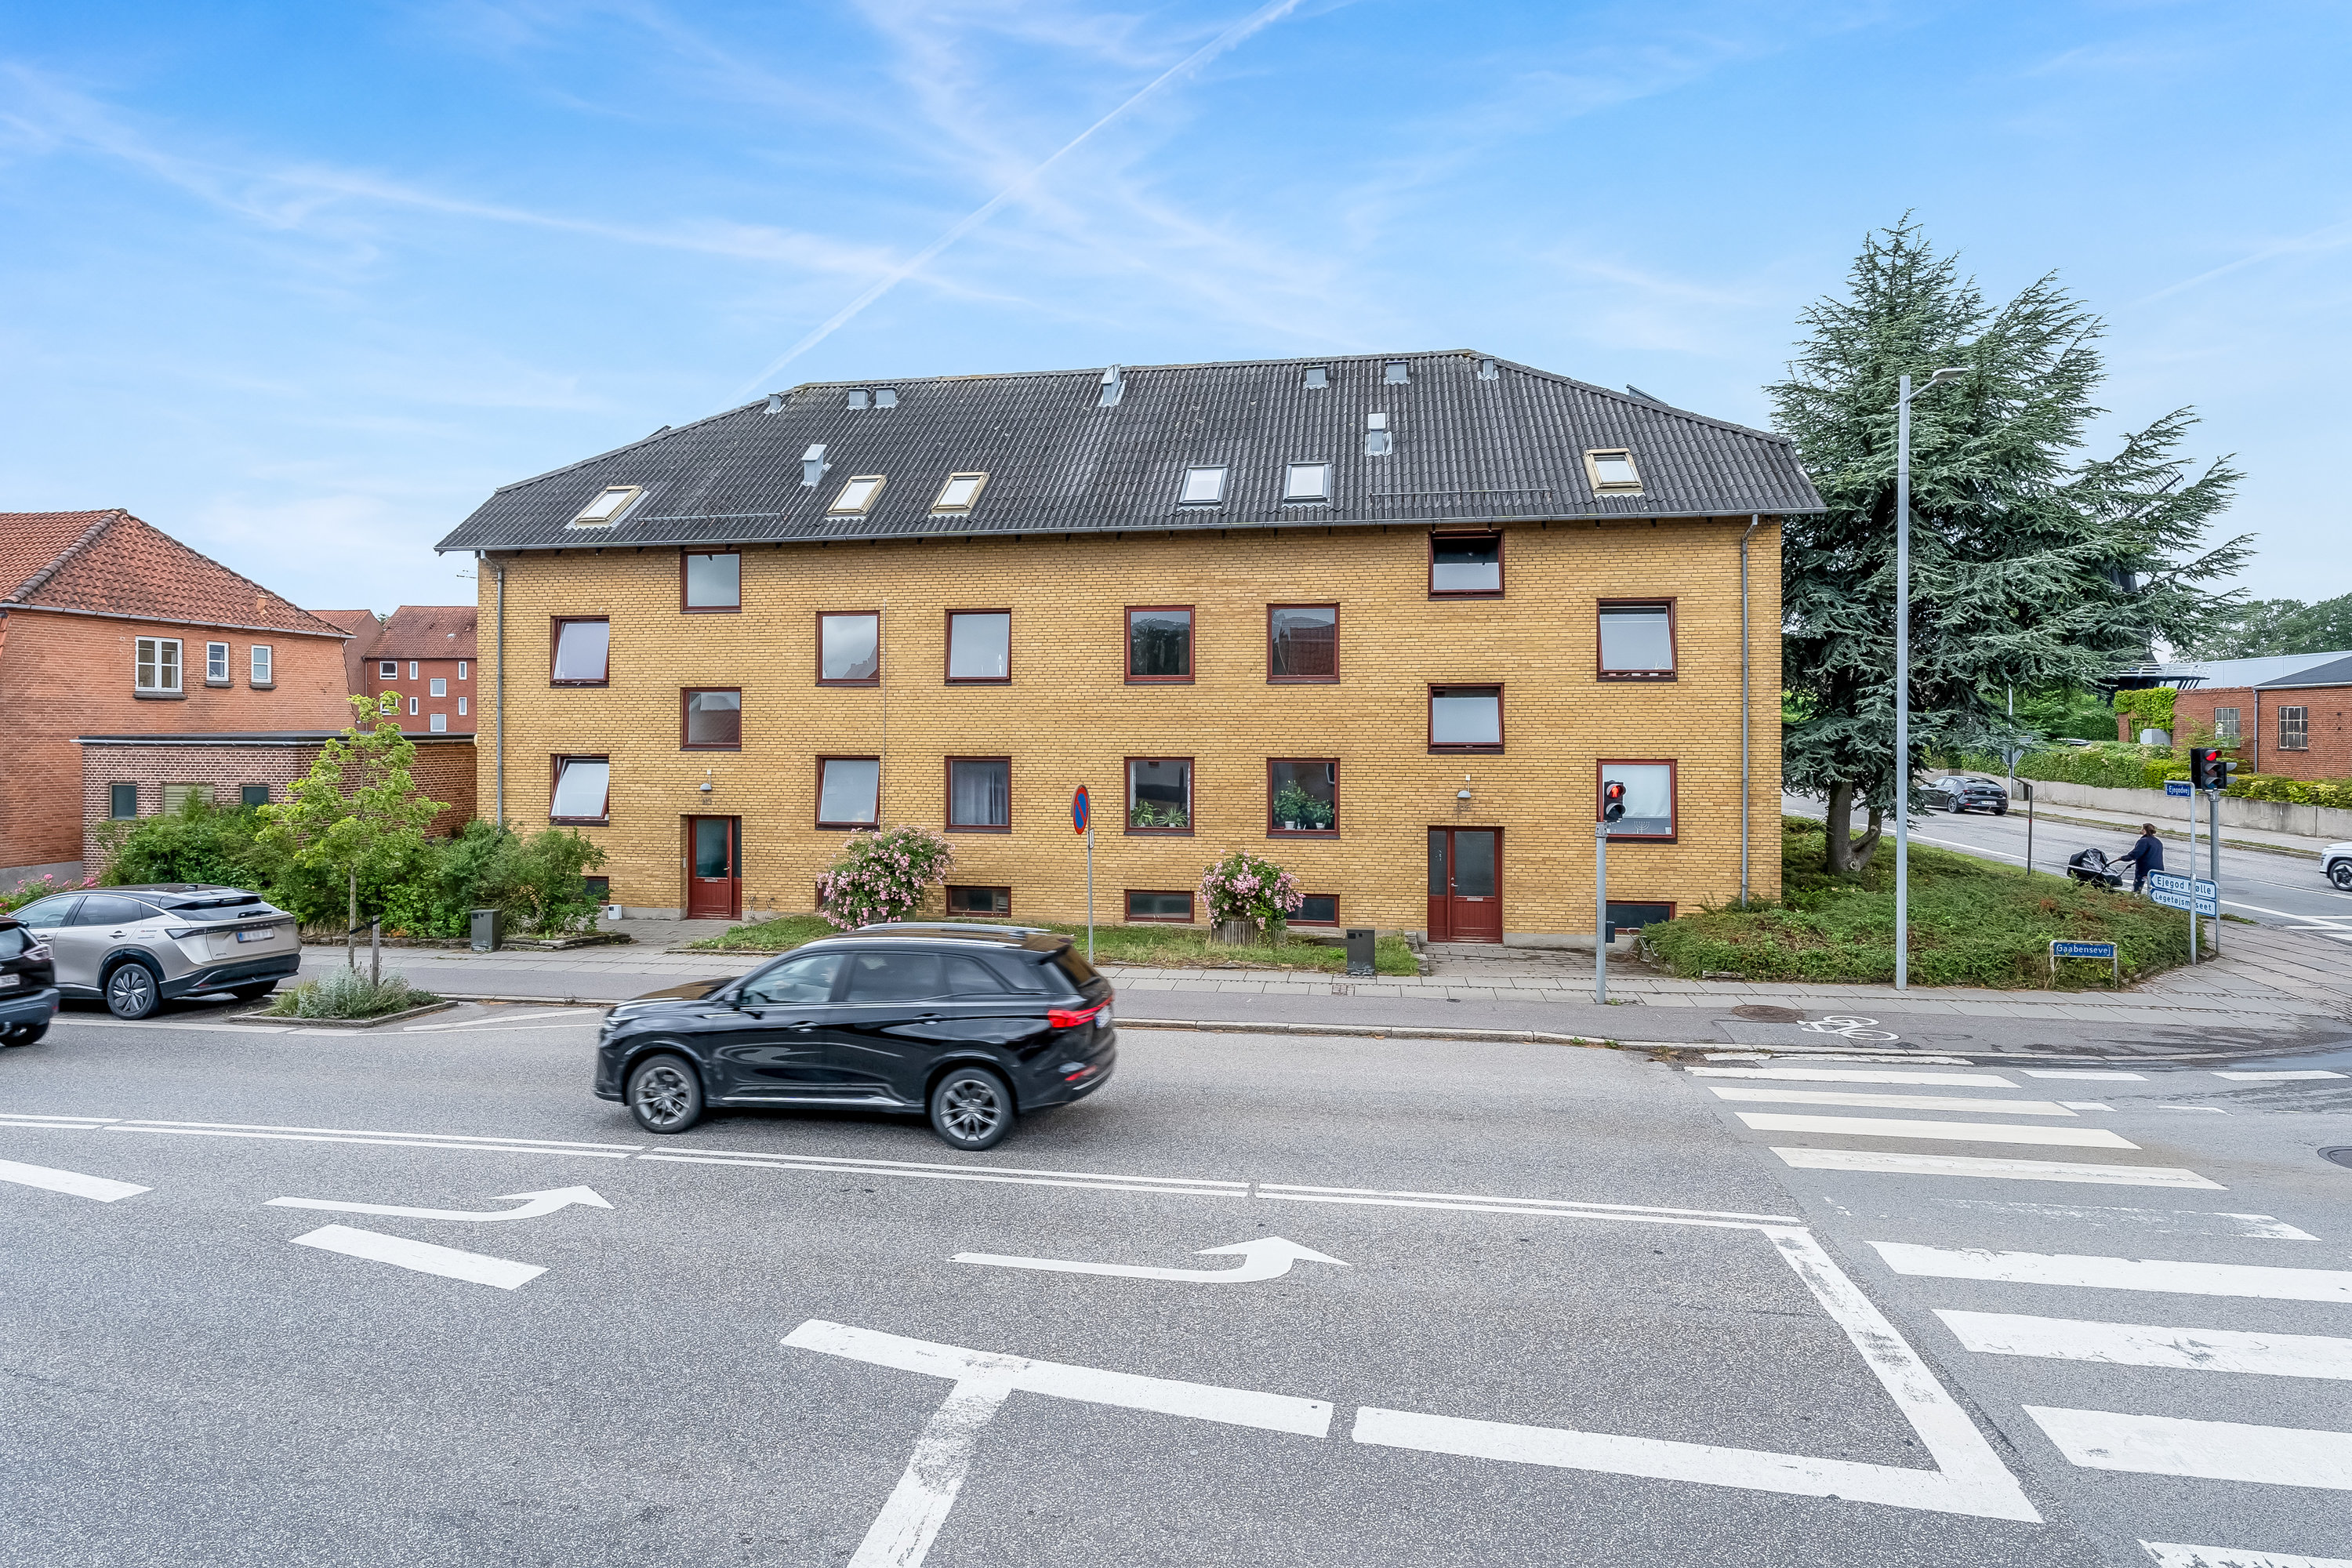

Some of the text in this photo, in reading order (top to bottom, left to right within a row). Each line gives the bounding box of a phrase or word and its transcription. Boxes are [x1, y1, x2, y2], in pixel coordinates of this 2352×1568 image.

[2169, 786, 2190, 796] Ejegodvej
[2157, 877, 2184, 889] Ejegod
[2155, 893, 2212, 911] Legetøjsmseet
[2056, 944, 2111, 956] Gaabensevej
